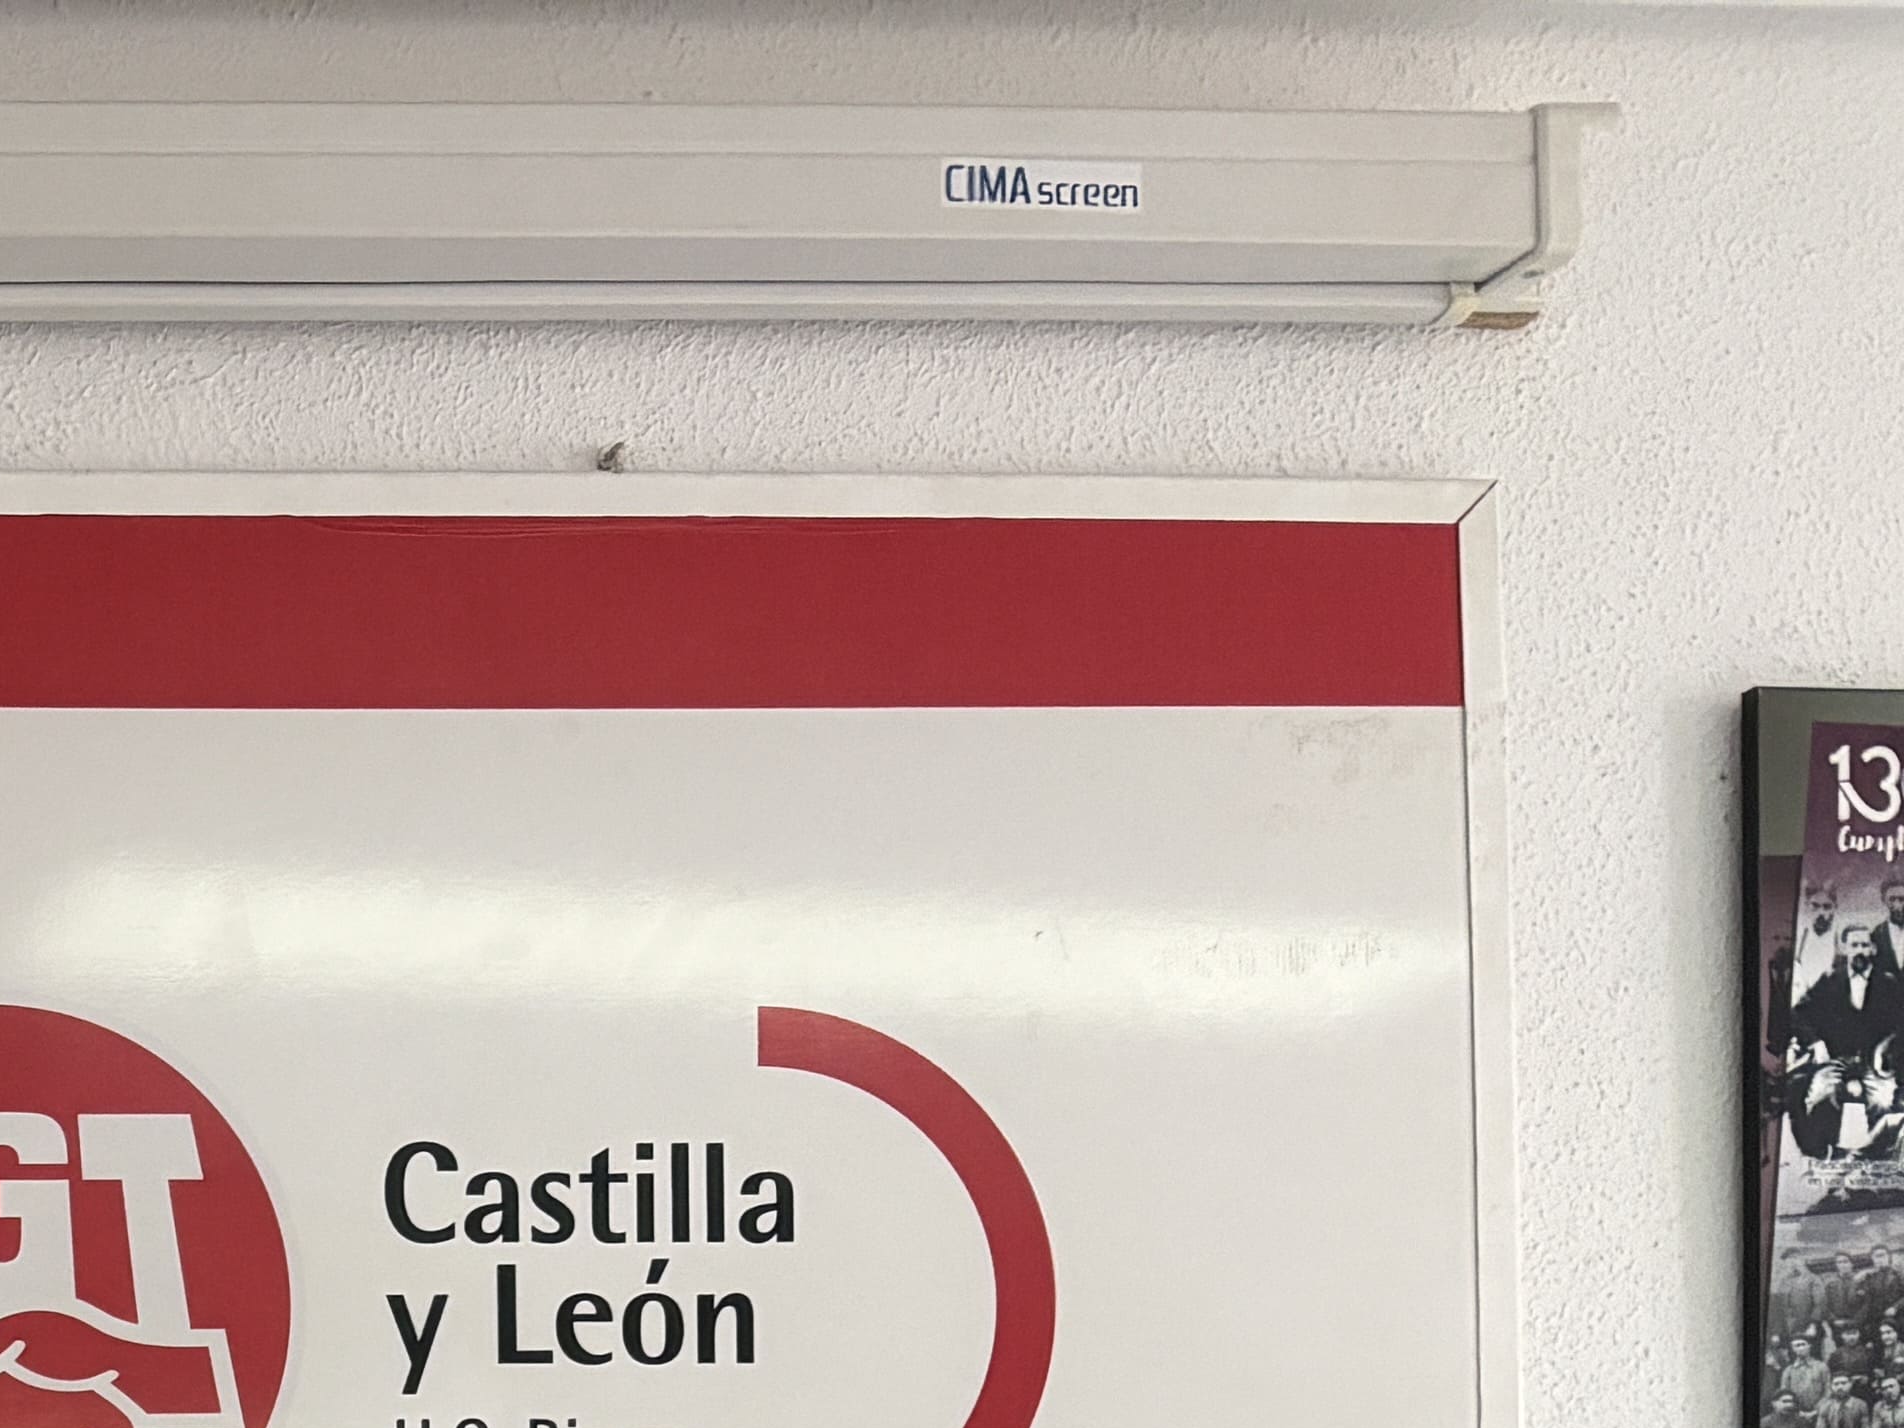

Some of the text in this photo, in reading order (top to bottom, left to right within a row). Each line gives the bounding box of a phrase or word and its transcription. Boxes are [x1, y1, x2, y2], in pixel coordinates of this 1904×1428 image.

[945, 164, 1139, 208] CIMA screen
[1828, 744, 1904, 822] 13
[384, 1141, 795, 1244] Castilla
[385, 1258, 755, 1396] y León
